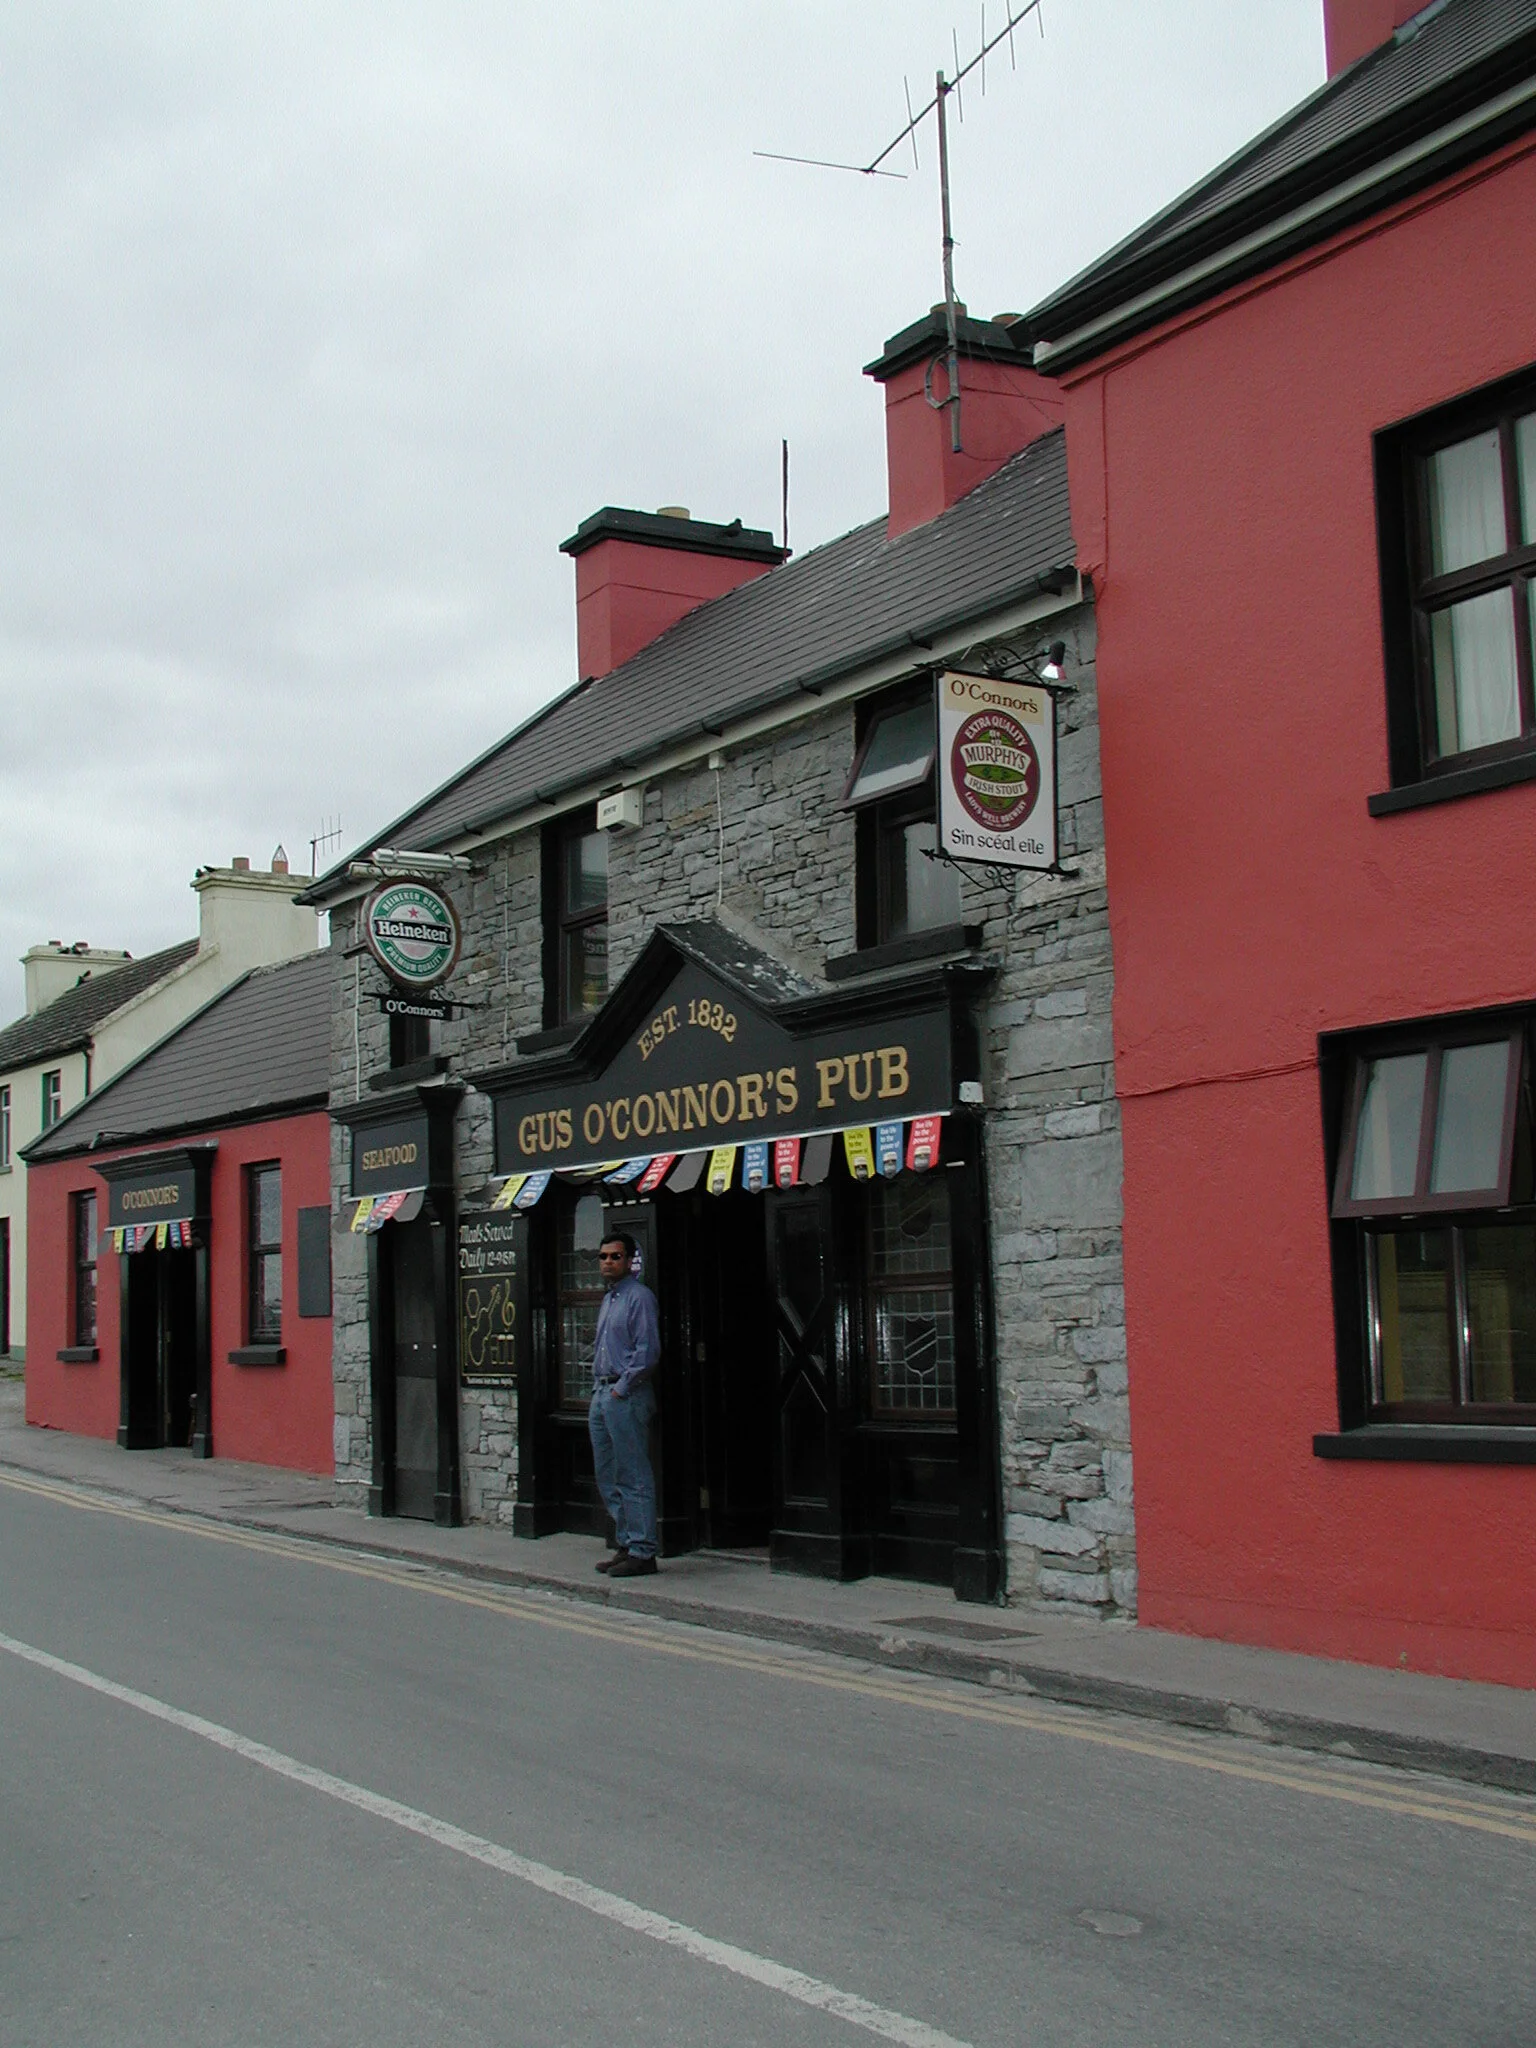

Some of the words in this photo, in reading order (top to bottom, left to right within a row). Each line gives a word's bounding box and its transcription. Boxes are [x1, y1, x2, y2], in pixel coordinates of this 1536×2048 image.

[951, 679, 1039, 714] O'Connor's
[964, 715, 991, 740] EXTRA
[992, 715, 1028, 748] QUALITY
[969, 777, 994, 793] IRISH
[995, 782, 1025, 795] STOUT
[951, 828, 975, 847] Sin
[977, 833, 1016, 852] scéal
[1018, 838, 1045, 855] eile
[377, 920, 448, 943] Heineken
[636, 1006, 681, 1062] EST.
[687, 998, 739, 1043] 1832
[517, 1107, 574, 1156] GUS
[582, 1065, 799, 1145] O'CONNOR'S
[814, 1044, 911, 1109] PUB
[362, 1143, 417, 1171] SEAFOOD
[459, 1247, 485, 1273] Daily
